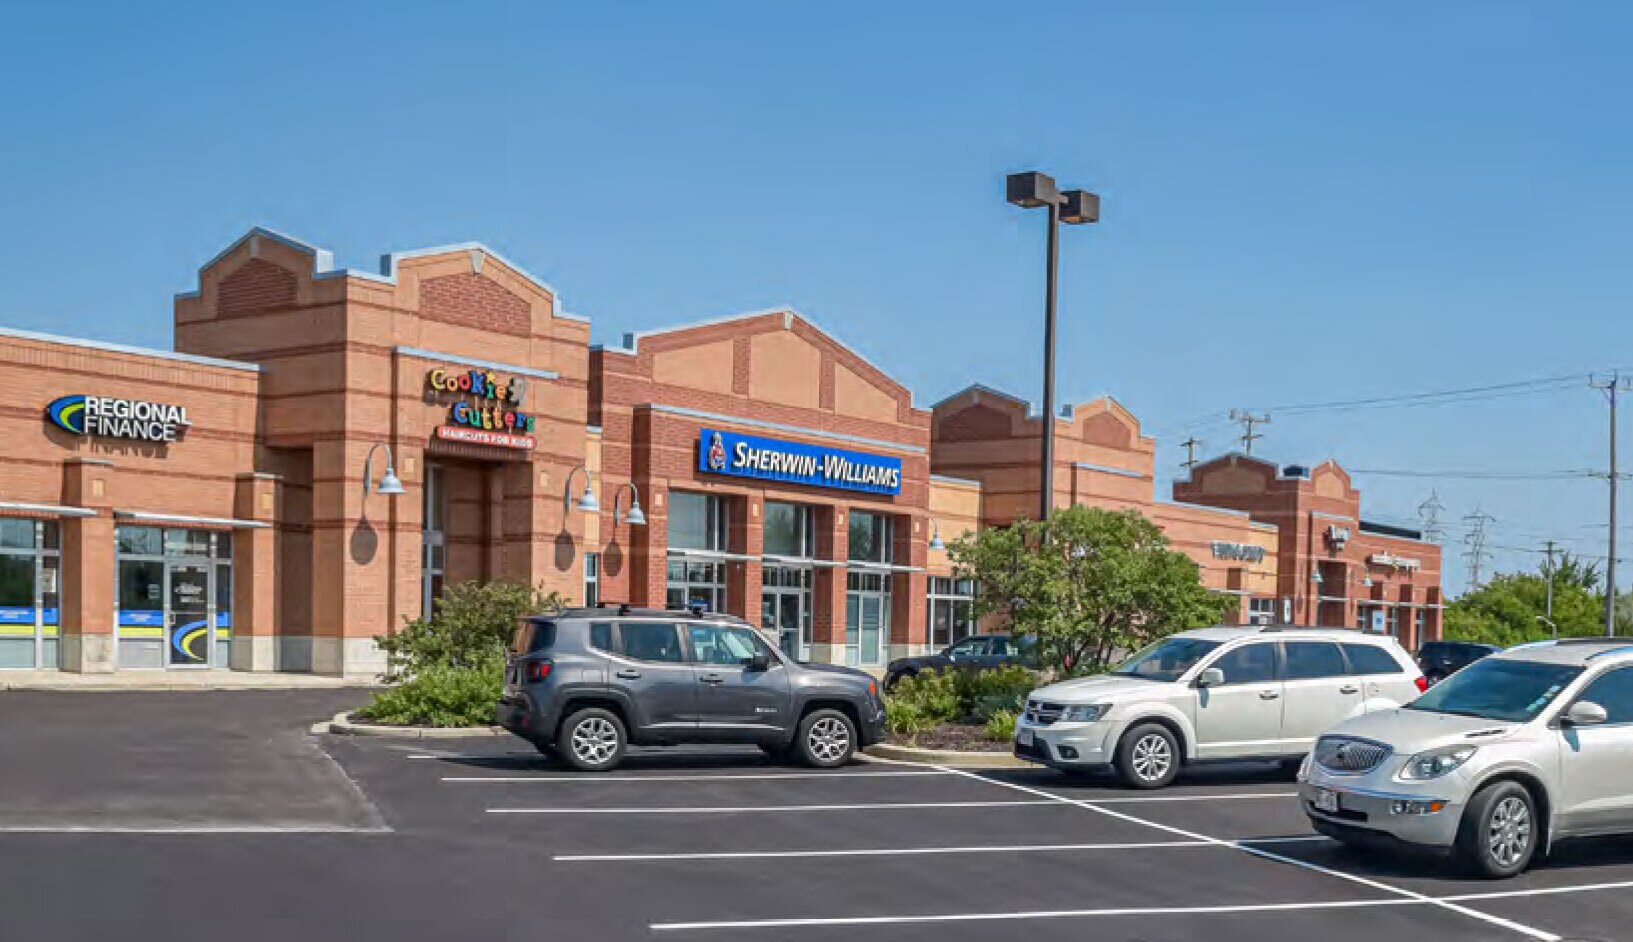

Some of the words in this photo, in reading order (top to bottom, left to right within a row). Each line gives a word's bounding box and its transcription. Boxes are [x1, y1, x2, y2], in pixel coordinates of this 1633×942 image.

[431, 369, 506, 400] Cookie
[84, 396, 192, 425] REGIONAL
[454, 401, 535, 432] Cutters
[84, 416, 177, 441] FINANCE
[442, 428, 490, 443] HAIRCUTS
[491, 434, 509, 445] FOR
[733, 442, 900, 487] SHERWIN-WILLIAMS
